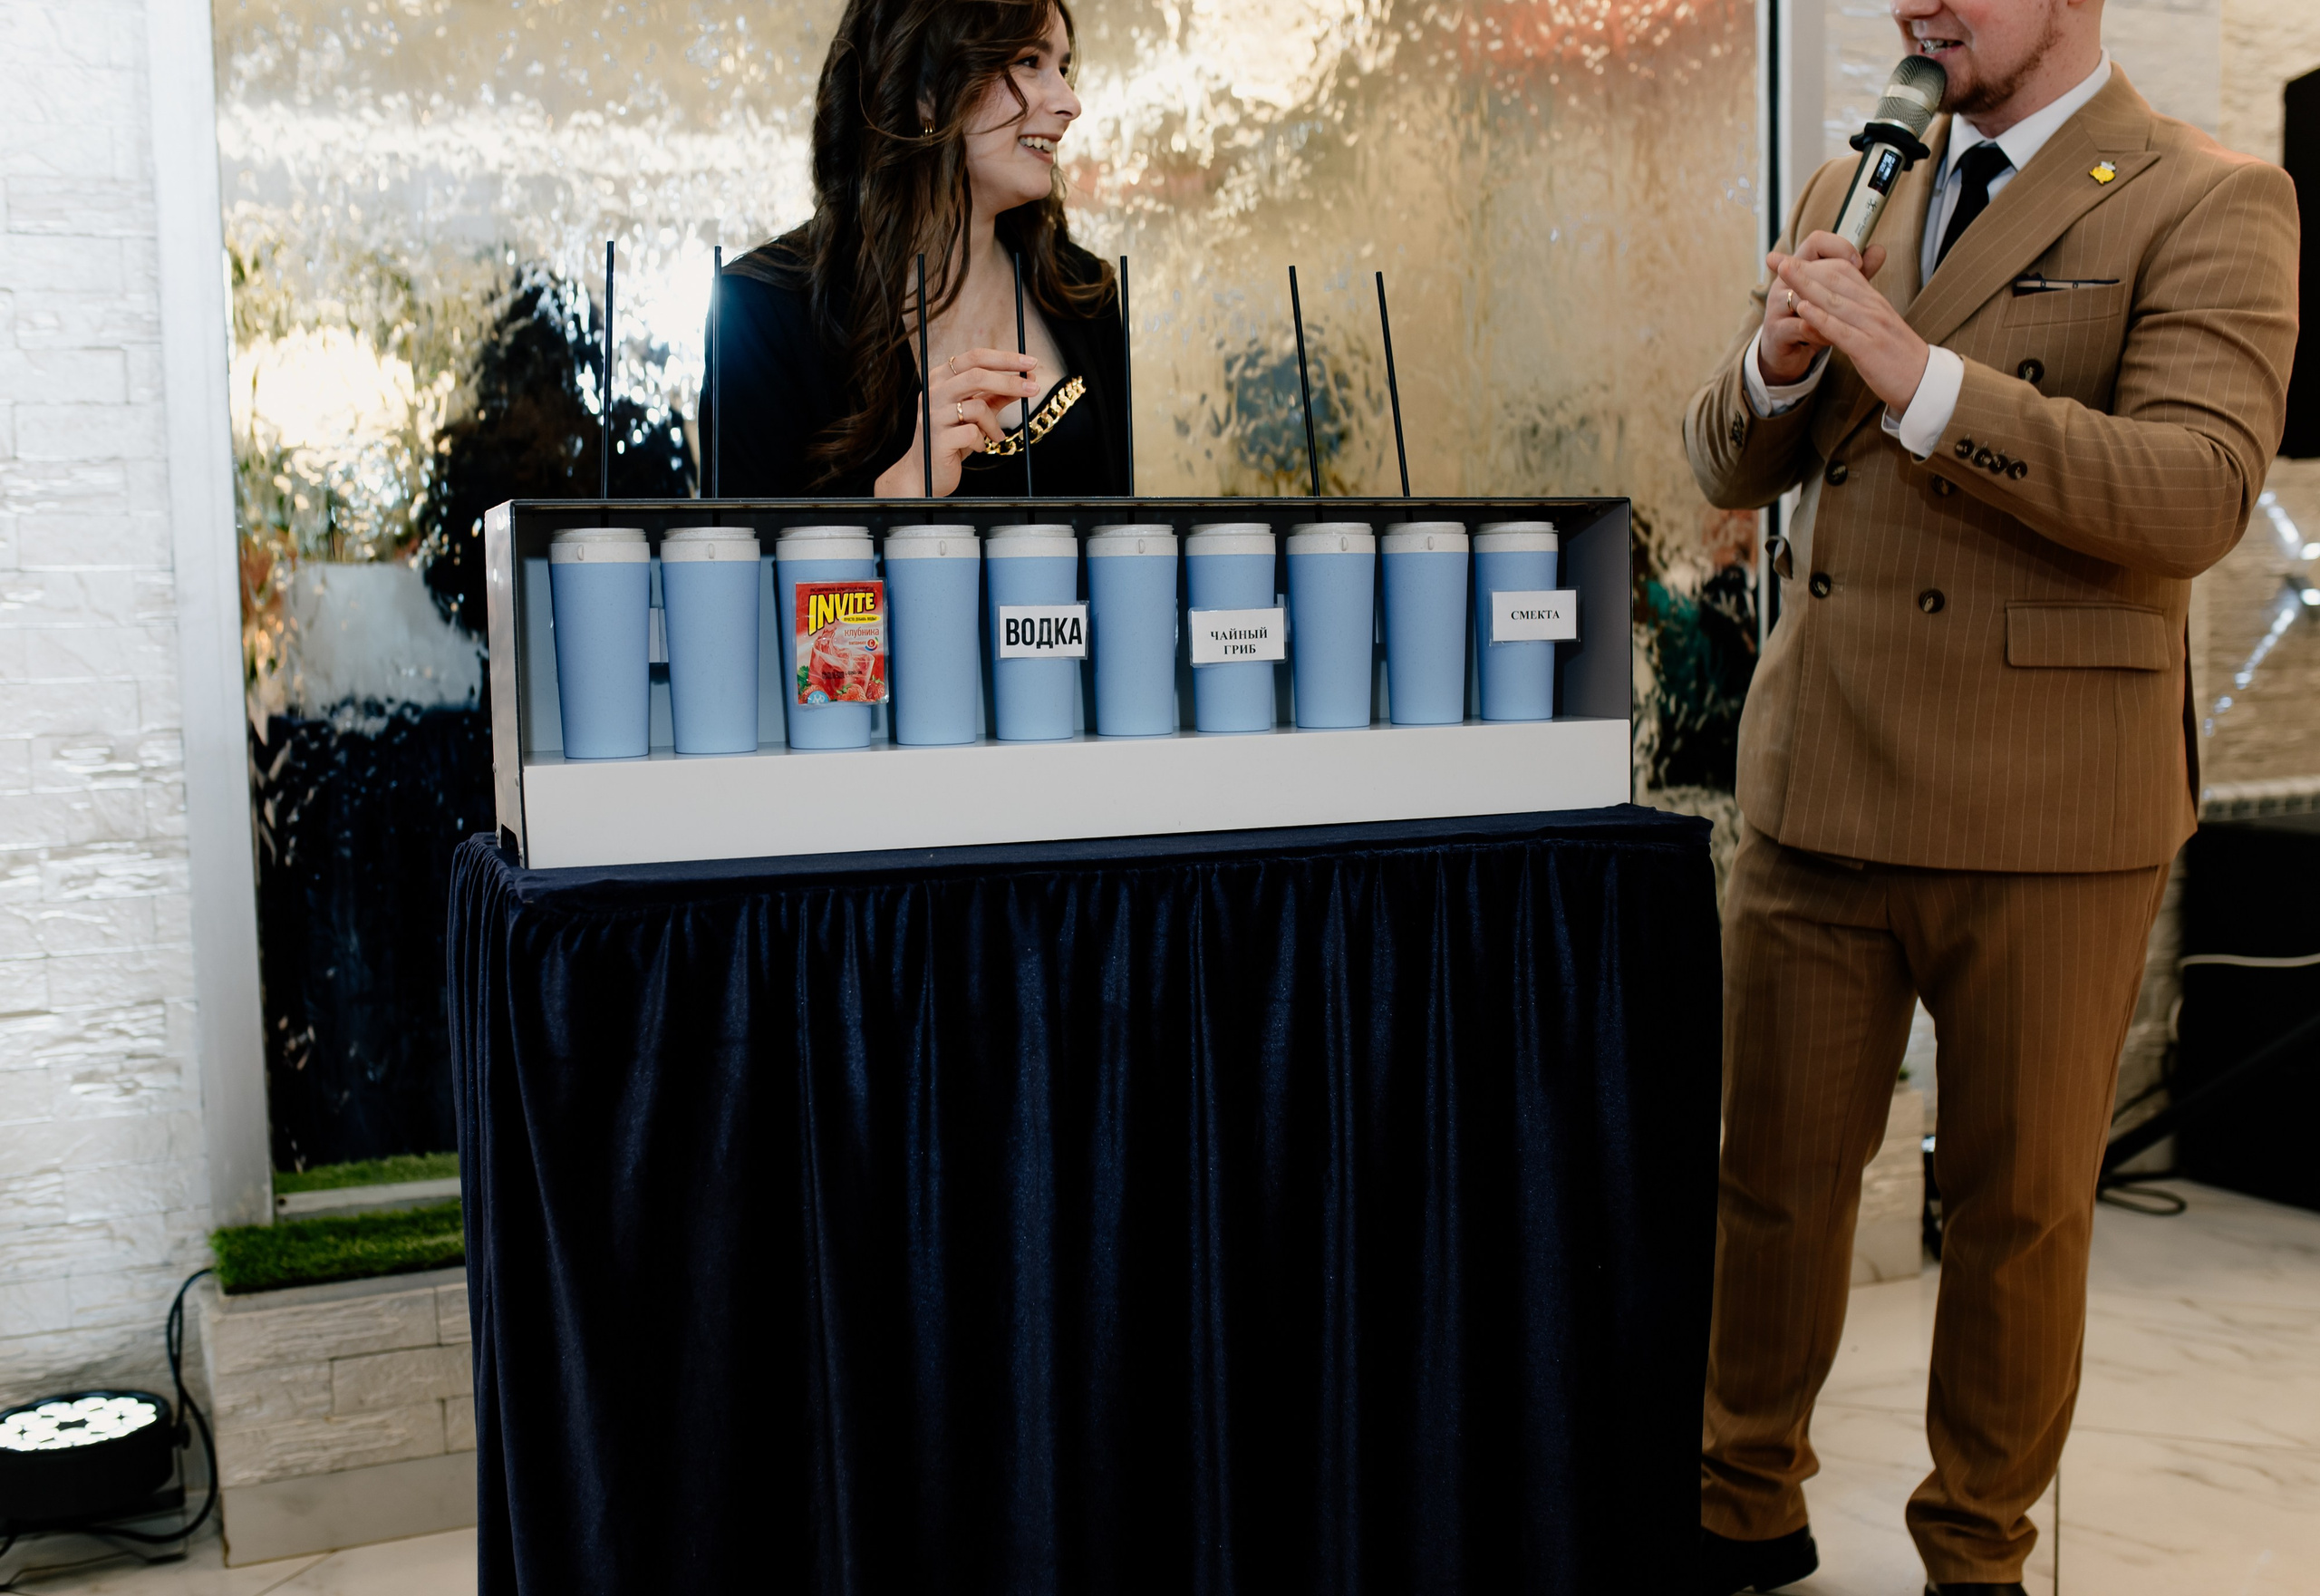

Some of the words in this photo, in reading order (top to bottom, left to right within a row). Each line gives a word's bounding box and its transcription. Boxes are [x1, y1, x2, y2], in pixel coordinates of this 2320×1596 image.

[808, 592, 875, 636] INVITE
[1511, 610, 1560, 620] СМЕКТА
[844, 626, 880, 639] клубника
[1005, 617, 1083, 649] ВОДКА
[1210, 626, 1268, 642] ЧАЙНЫЙ
[1223, 643, 1256, 655] ГРИБ
